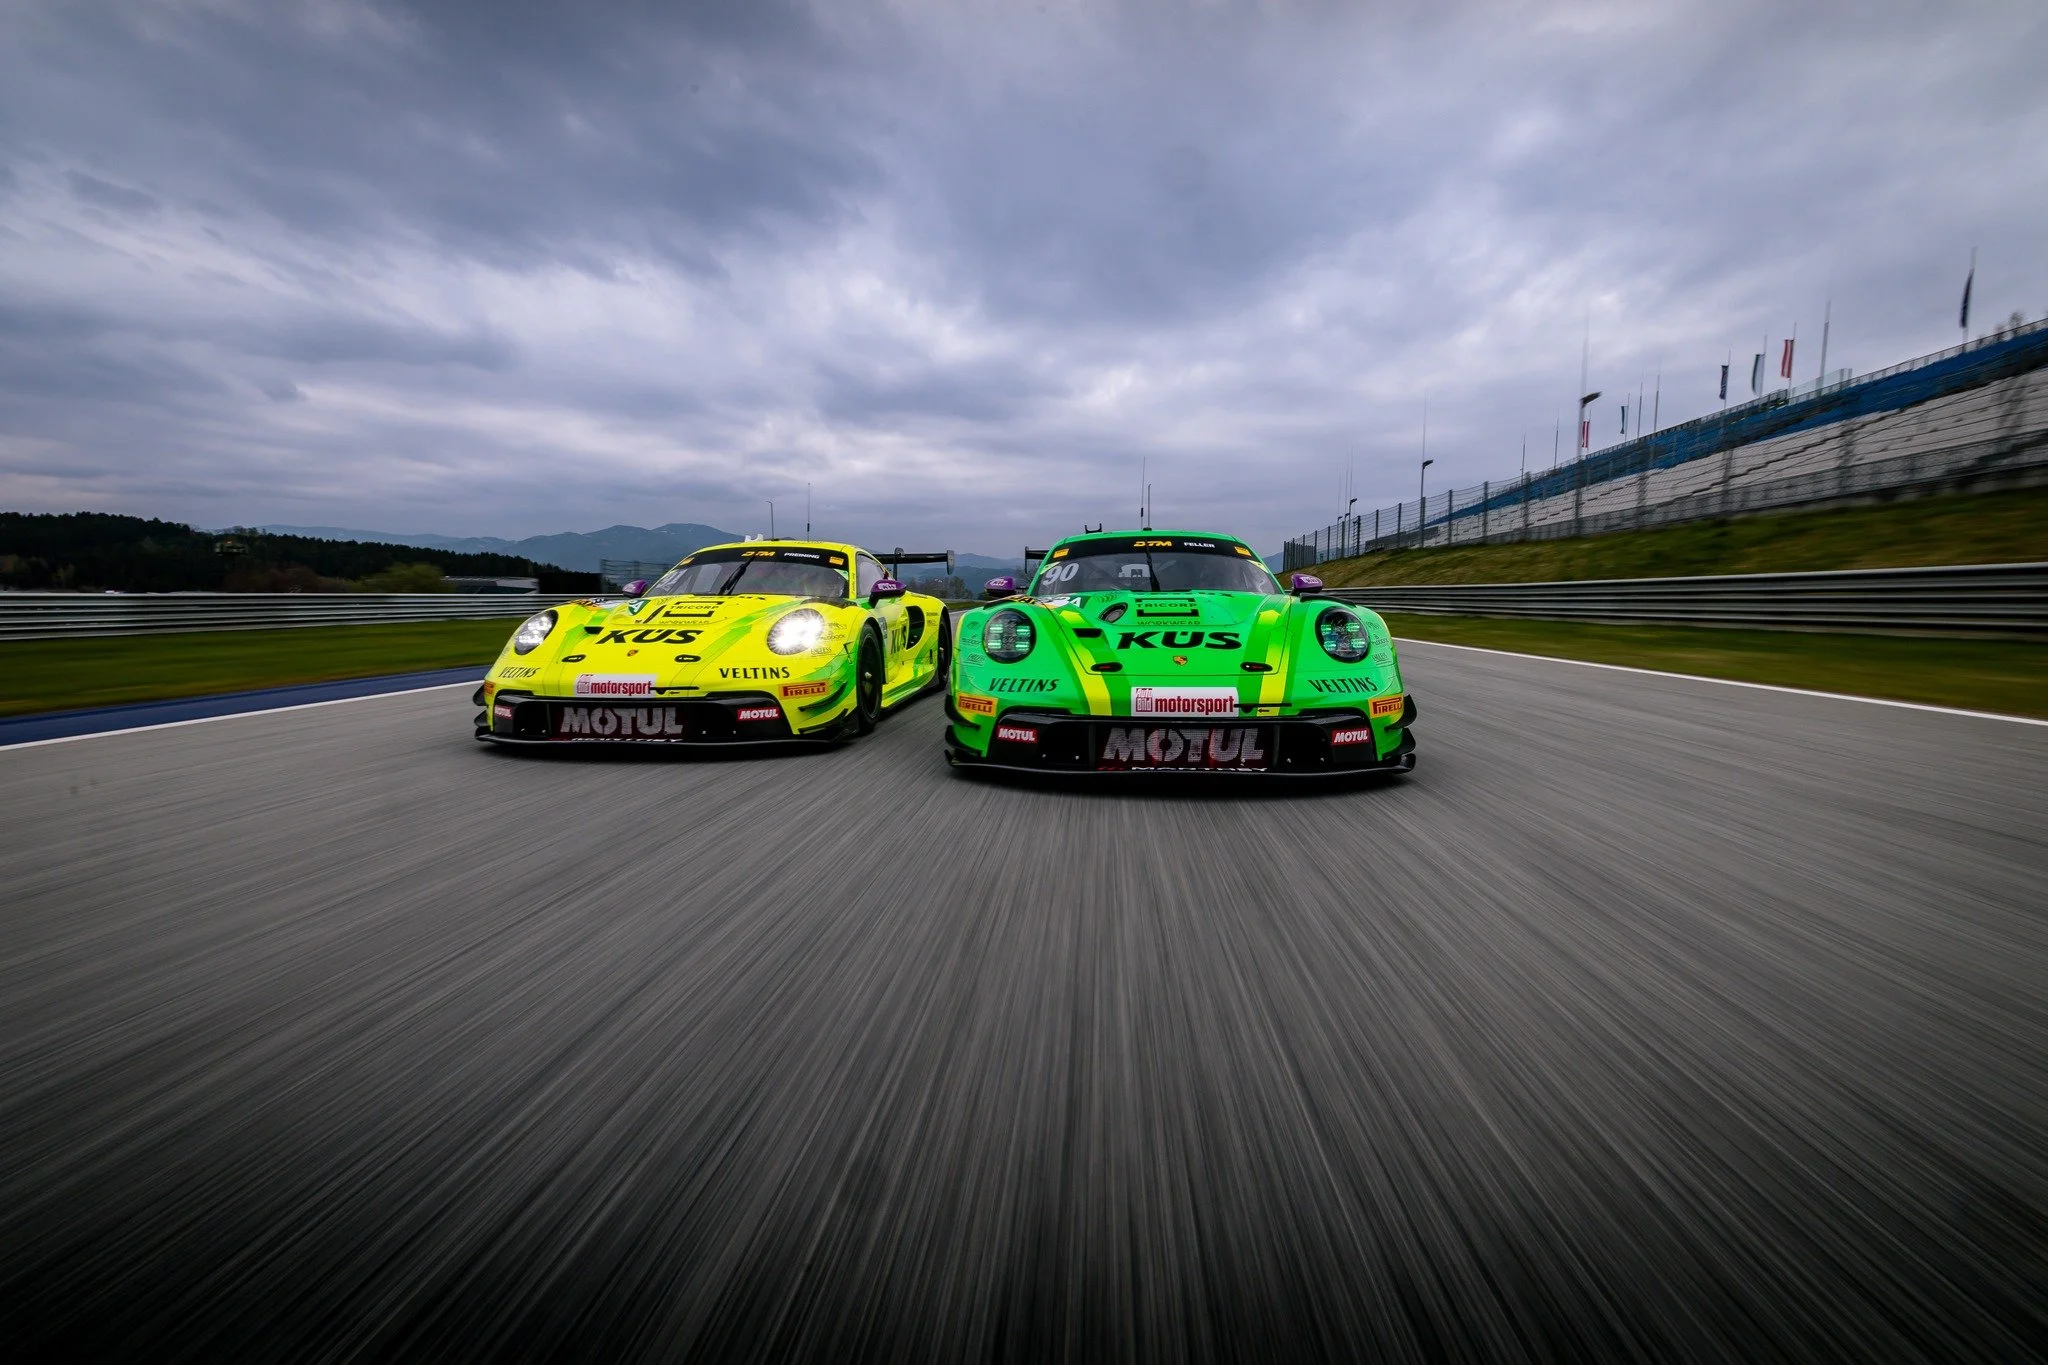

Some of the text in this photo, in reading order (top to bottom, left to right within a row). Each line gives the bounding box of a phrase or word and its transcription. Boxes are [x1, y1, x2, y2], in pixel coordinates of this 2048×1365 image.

[783, 552, 820, 560] PREINING
[1042, 562, 1080, 587] 90
[595, 629, 704, 645] KÜS
[1117, 631, 1243, 650] KÜS
[499, 666, 541, 679] VELTINS
[719, 666, 791, 680] VELTINS
[590, 680, 653, 696] motorsport
[782, 681, 827, 697] PIRELLI
[988, 678, 1061, 693] VELTINS
[1308, 676, 1379, 693] VELTINS
[1155, 695, 1235, 716] motorsport
[560, 706, 684, 736] MOTUL
[739, 708, 779, 720] MOTUL
[998, 727, 1036, 741] MOTUL
[1333, 729, 1369, 744] MOTUL
[1102, 727, 1264, 763] MOTUL
